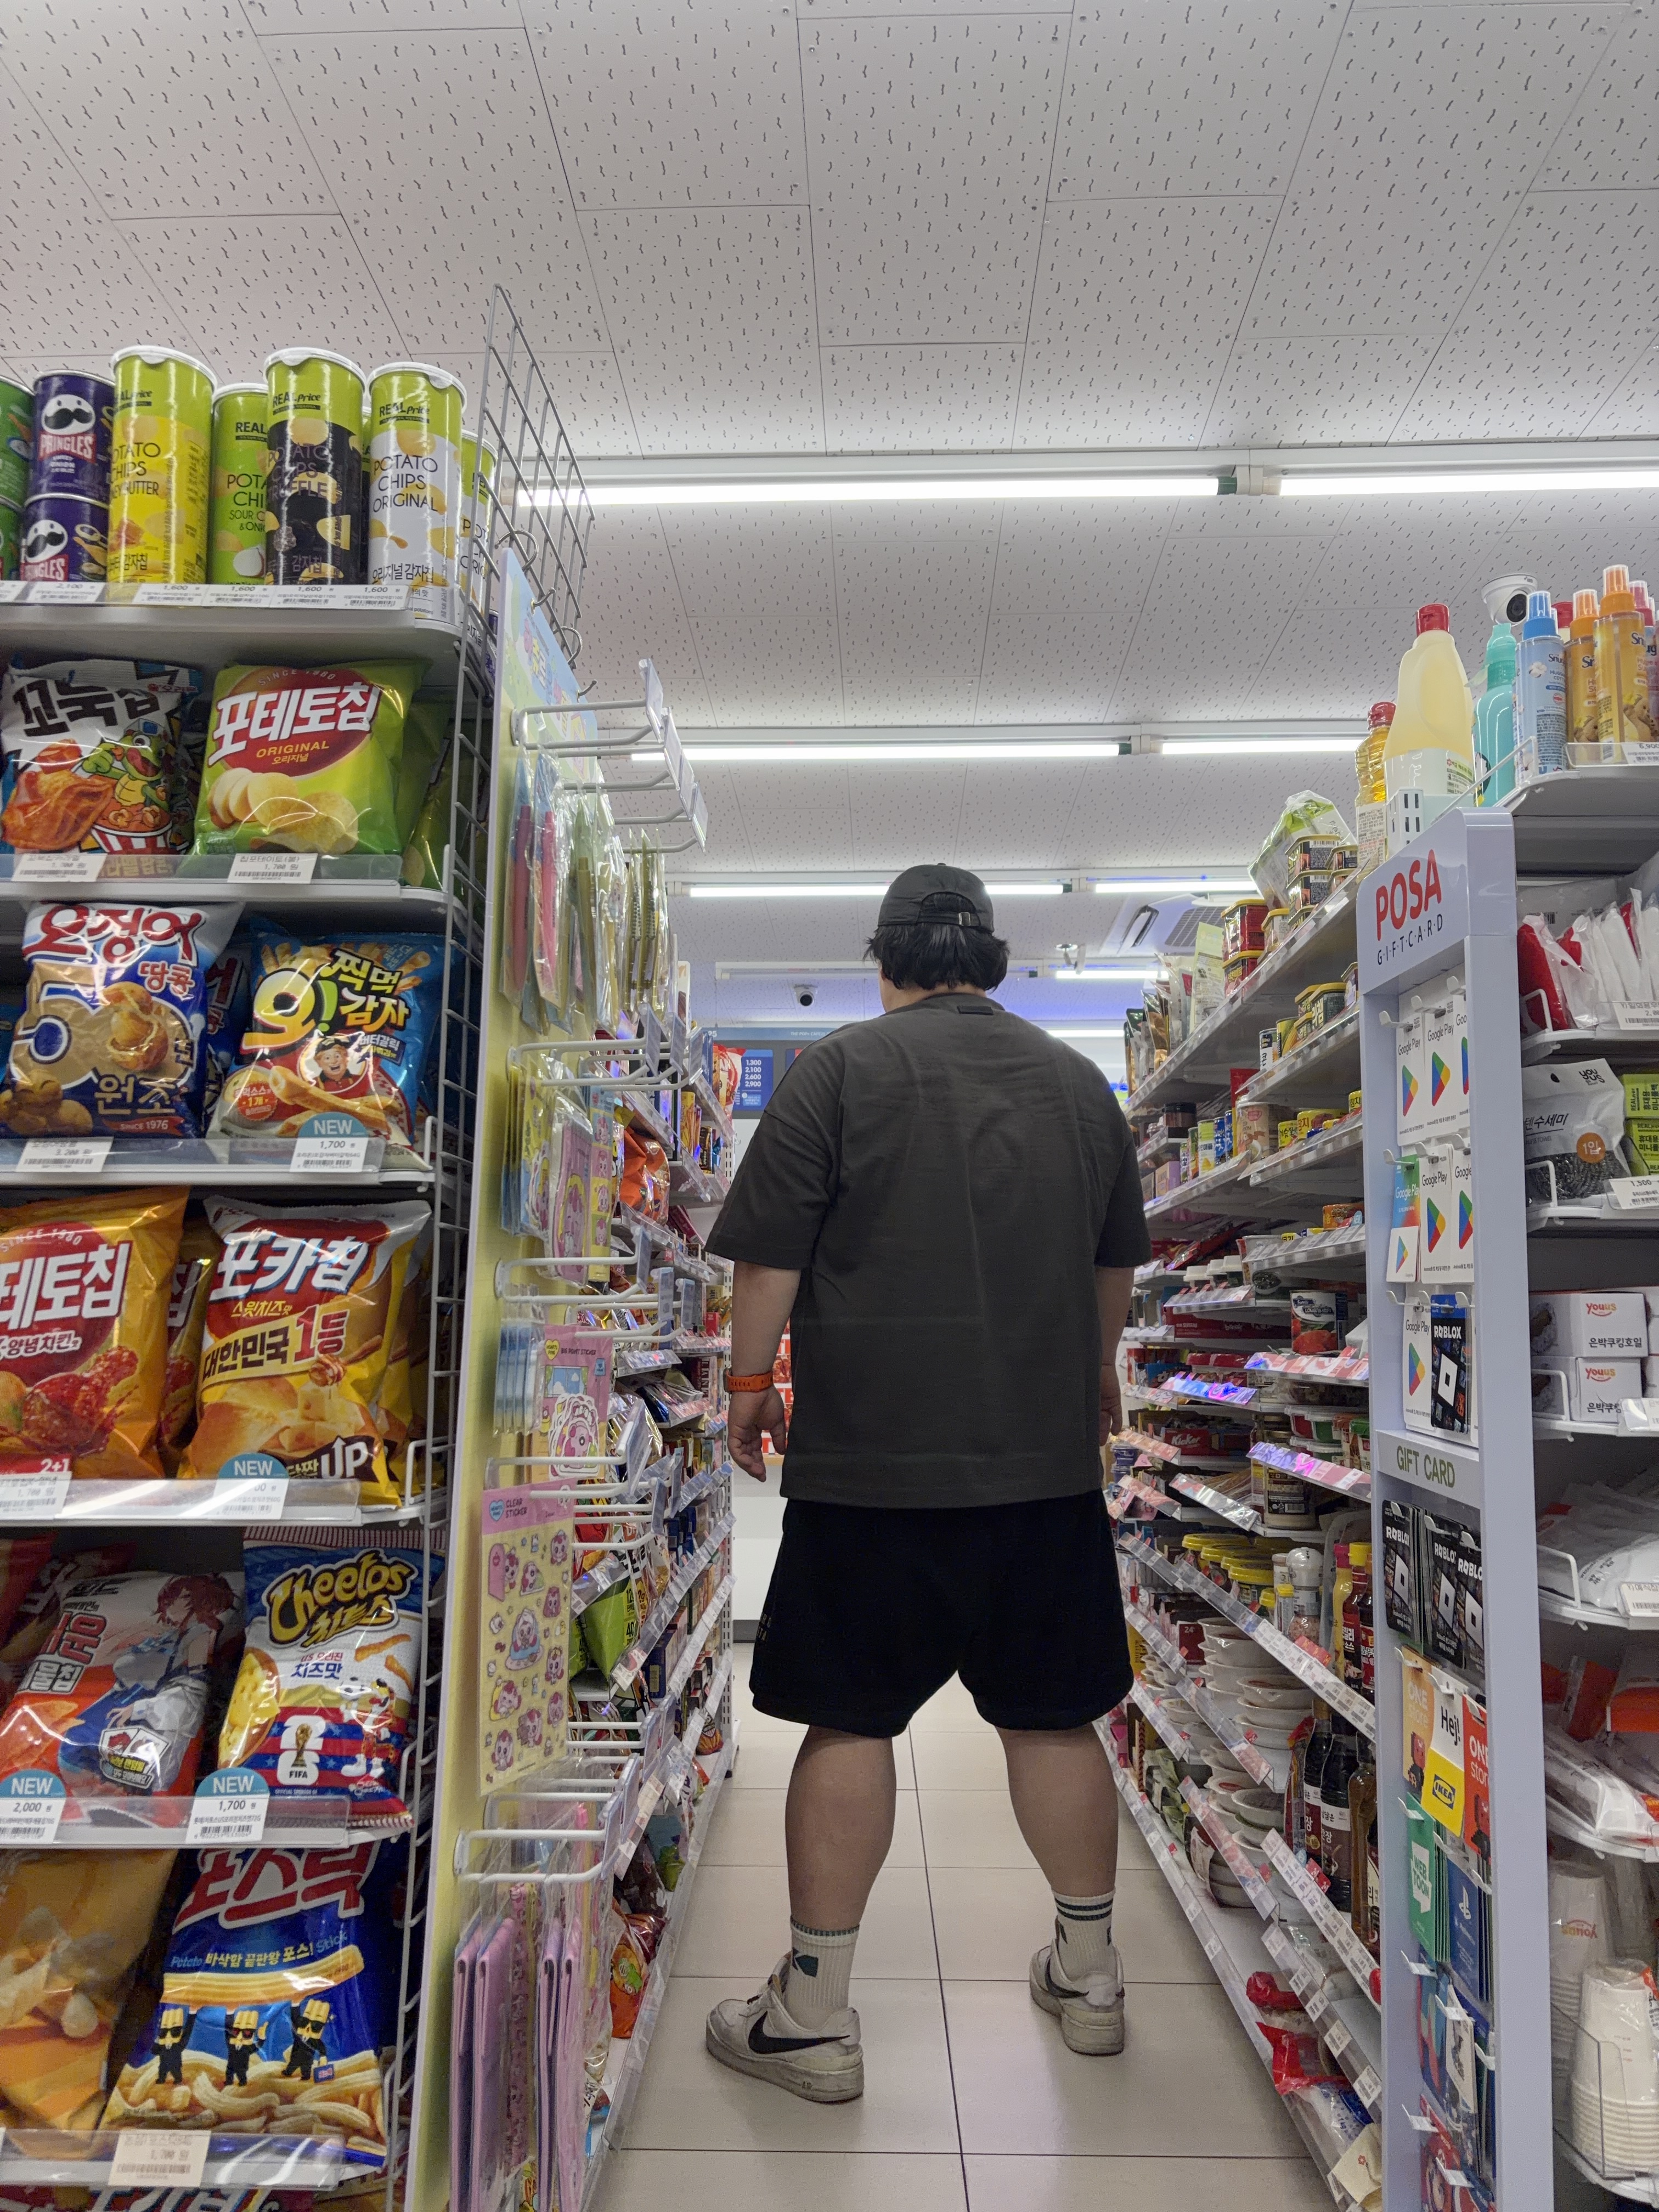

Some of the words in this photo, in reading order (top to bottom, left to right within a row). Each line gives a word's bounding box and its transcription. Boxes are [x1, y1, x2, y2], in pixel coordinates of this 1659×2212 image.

[380, 403, 404, 417] REAL
[235, 422, 267, 435] REAL
[40, 433, 94, 460] PRINGLES
[374, 454, 438, 476] POTATO
[378, 473, 426, 492] CHIPS
[373, 493, 438, 514] ORIGINAL
[229, 510, 253, 520] SOUR
[404, 563, 435, 584] 감자칩
[258, 668, 298, 687] SINCE
[207, 682, 382, 766] 포테토칩
[256, 741, 330, 759] ORIGINAL
[273, 752, 309, 765] 오리지널
[1375, 848, 1443, 942] POSA
[24, 905, 205, 967] 오징어
[139, 961, 194, 996] 땅콩
[338, 987, 411, 1032] 감자
[1427, 1027, 1444, 1042] Google
[1444, 1023, 1454, 1036] Play
[1398, 1040, 1412, 1056] Google
[1412, 1038, 1421, 1050] Play
[94, 1071, 179, 1116] 원조
[146, 1119, 169, 1130] 1976
[314, 1119, 353, 1135] NEW
[320, 1140, 346, 1149] 1,700
[1421, 1174, 1437, 1188] Google
[1437, 1171, 1447, 1186] Play
[1395, 1185, 1410, 1201] Google
[52, 1228, 82, 1246] 1980
[211, 1231, 369, 1302] 포카칩
[1585, 1302, 1617, 1315] youus
[1406, 1319, 1420, 1335] Google
[1421, 1321, 1430, 1336] Play
[1434, 1325, 1462, 1339] ROBLOX
[202, 1324, 291, 1385] 대한민국
[294, 1304, 350, 1365] 1등
[1588, 1337, 1643, 1348] 은박쿠킹호일
[1585, 1367, 1616, 1380] youus
[41, 1458, 70, 1473] 2+1
[234, 1459, 273, 1476] NEW
[320, 1437, 368, 1480] UP
[1396, 1445, 1420, 1476] GIFT
[1424, 1454, 1455, 1488] CARD
[505, 1498, 523, 1508] CLEAR
[505, 1507, 528, 1519] STICKER
[267, 1550, 413, 1643] Cheetos
[291, 1661, 343, 1680] 치즈맛
[1440, 1705, 1460, 1747] Hej!
[289, 1770, 308, 1779] FIFA
[11, 1777, 54, 1795] NEW
[212, 1775, 254, 1794] NEW
[1435, 1782, 1453, 1803] IKEA
[13, 1802, 42, 1812] 2,000
[219, 1800, 246, 1812] 1,700
[205, 1951, 242, 1968] 바삭함
[244, 1950, 281, 1968] 끝판왕
[282, 1942, 314, 1963] 포스!
